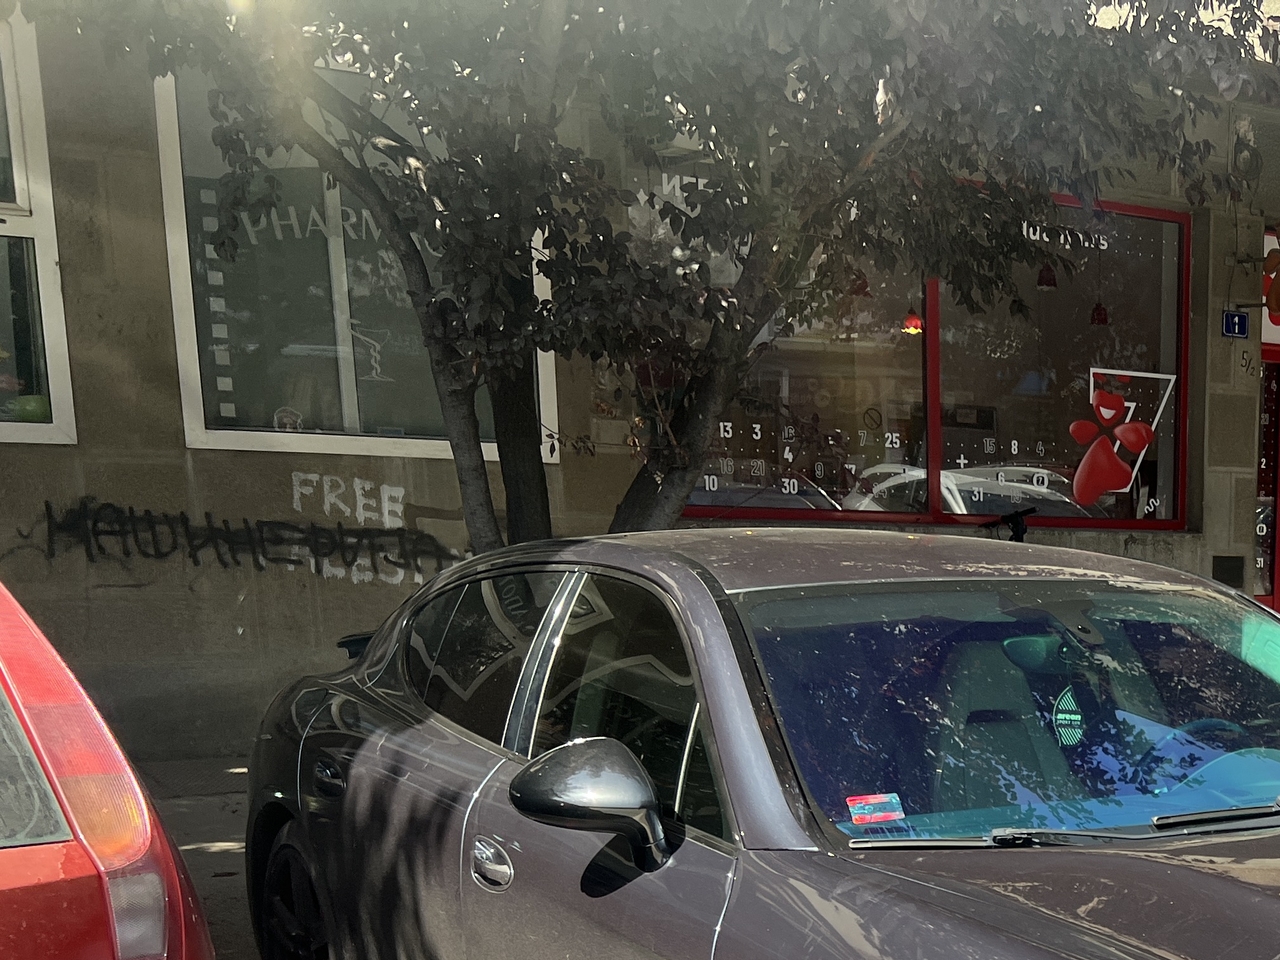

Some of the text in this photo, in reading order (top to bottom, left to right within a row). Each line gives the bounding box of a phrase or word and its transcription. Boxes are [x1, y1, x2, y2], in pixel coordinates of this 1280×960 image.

[1232, 315, 1240, 334] 1
[719, 422, 733, 438] 13
[752, 423, 762, 440] 3
[884, 432, 900, 448] 25
[783, 446, 794, 463] 4
[983, 437, 996, 454] 15
[1011, 440, 1019, 455] 8
[719, 457, 735, 475] 16
[750, 459, 766, 476] 21
[815, 462, 825, 479] 9
[704, 474, 718, 491] 10
[781, 478, 799, 494] 30
[291, 471, 406, 528] FREE
[971, 487, 984, 502] 31
